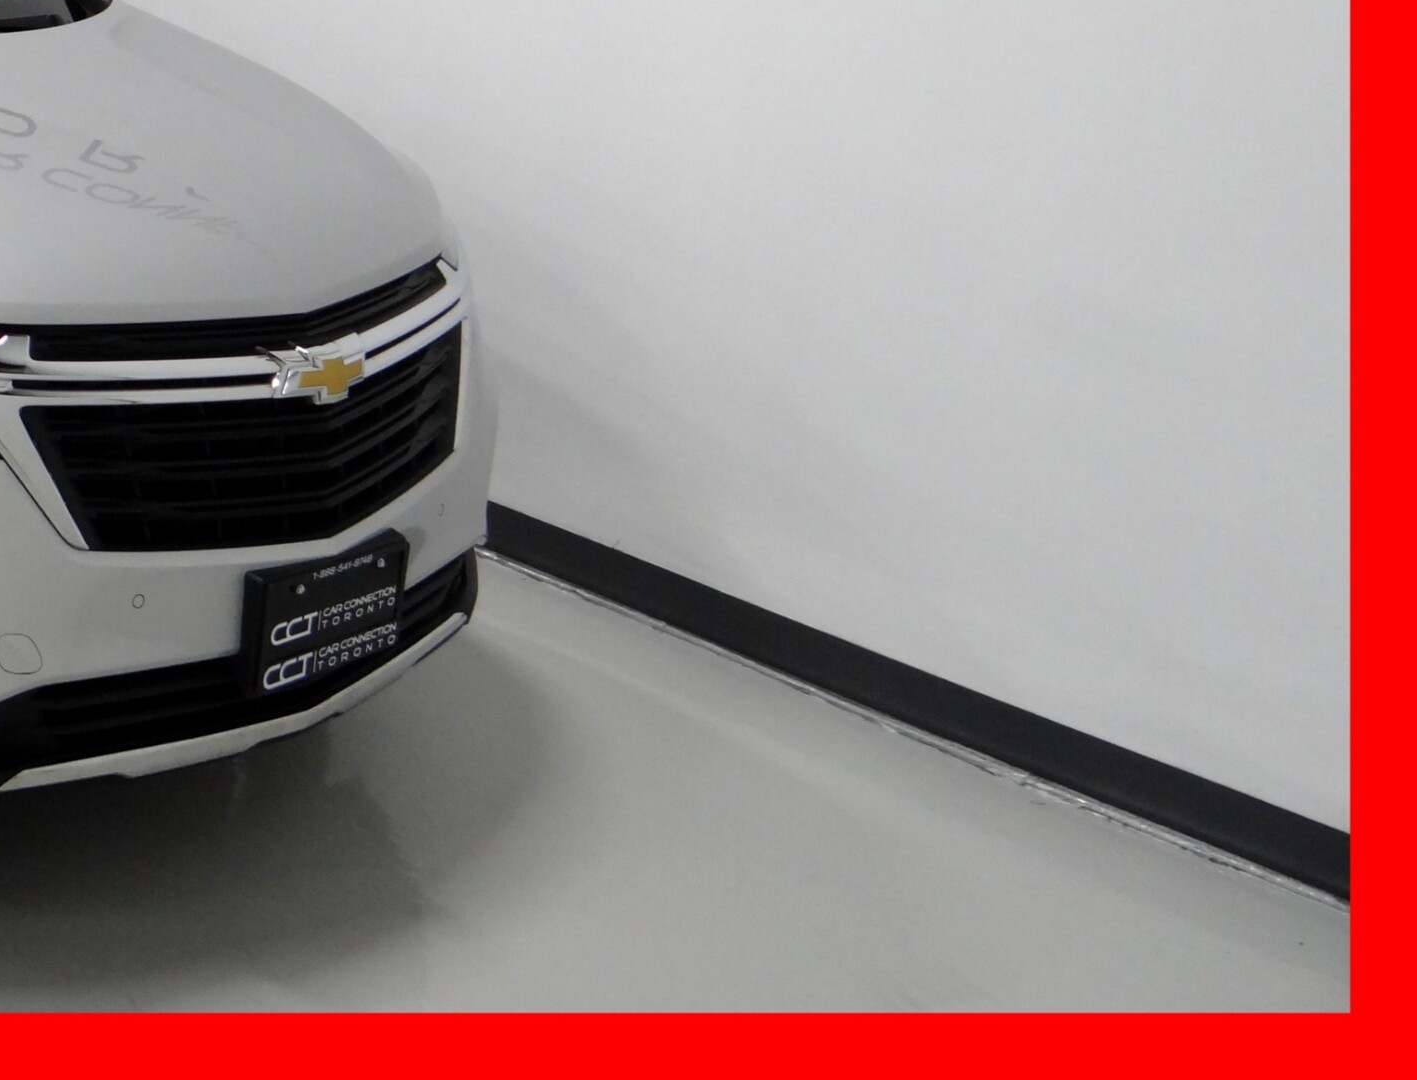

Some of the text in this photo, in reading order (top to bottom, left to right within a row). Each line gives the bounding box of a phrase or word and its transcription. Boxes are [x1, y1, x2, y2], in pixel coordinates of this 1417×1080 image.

[322, 597, 395, 629] TORONTO
[323, 585, 397, 617] CAR CONNECTION
[271, 611, 319, 646] CCT
[319, 622, 397, 658] CAR CONNECTION
[317, 634, 396, 670] TORONTO
[263, 652, 313, 690] CCT
